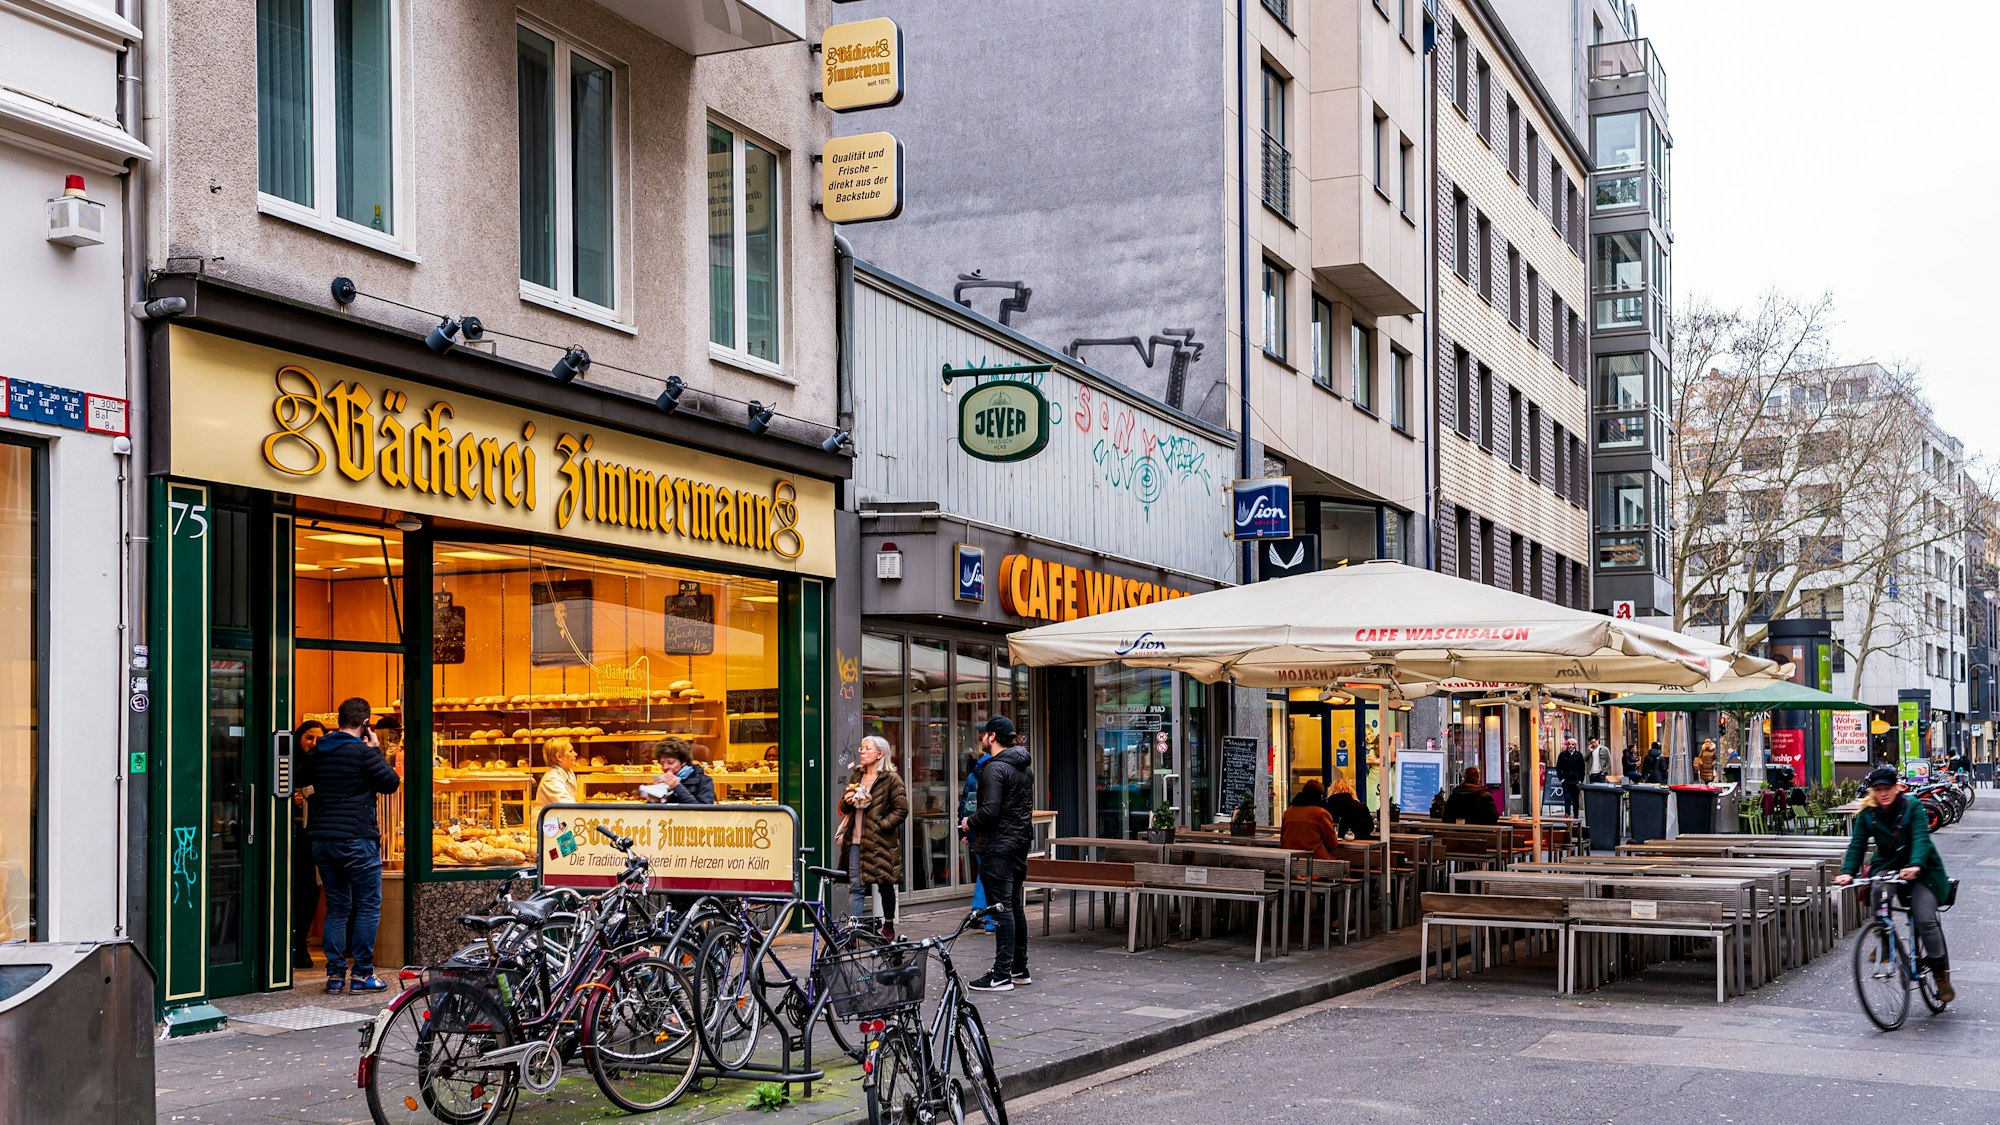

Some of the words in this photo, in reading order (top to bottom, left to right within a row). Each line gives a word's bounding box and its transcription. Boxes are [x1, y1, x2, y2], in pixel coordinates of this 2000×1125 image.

[831, 40, 886, 63] Bäckerei
[827, 61, 891, 86] Zimmermann
[878, 78, 891, 86] 1875
[832, 150, 866, 164] Qualität
[868, 148, 884, 159] und
[838, 165, 870, 176] Frische
[828, 179, 854, 191] direkt
[856, 178, 871, 188] aus
[873, 175, 888, 186] der
[836, 189, 881, 203] Backstube
[101, 400, 116, 410] 300
[975, 407, 1026, 438] JEVER
[262, 364, 538, 512] Bäckerei
[555, 431, 804, 559] Zimmermann
[1235, 495, 1287, 527] Sion
[168, 501, 208, 539] 75
[1000, 554, 1078, 622] CAFE
[1083, 569, 1193, 616] WASCH
[1354, 628, 1399, 642] CAFE
[1405, 627, 1530, 641] WASCHSALON
[1114, 632, 1167, 656] Sion
[1832, 737, 1867, 745] Zuhause
[1550, 786, 1564, 797] 70
[574, 817, 651, 846] Bäckerei
[658, 818, 771, 851] Zimmermann
[570, 853, 585, 866] Die
[588, 853, 672, 868] Traditionkerei
[675, 854, 688, 868] im
[690, 854, 725, 869] Herzen
[727, 858, 745, 870] von
[747, 855, 770, 870] Köln
